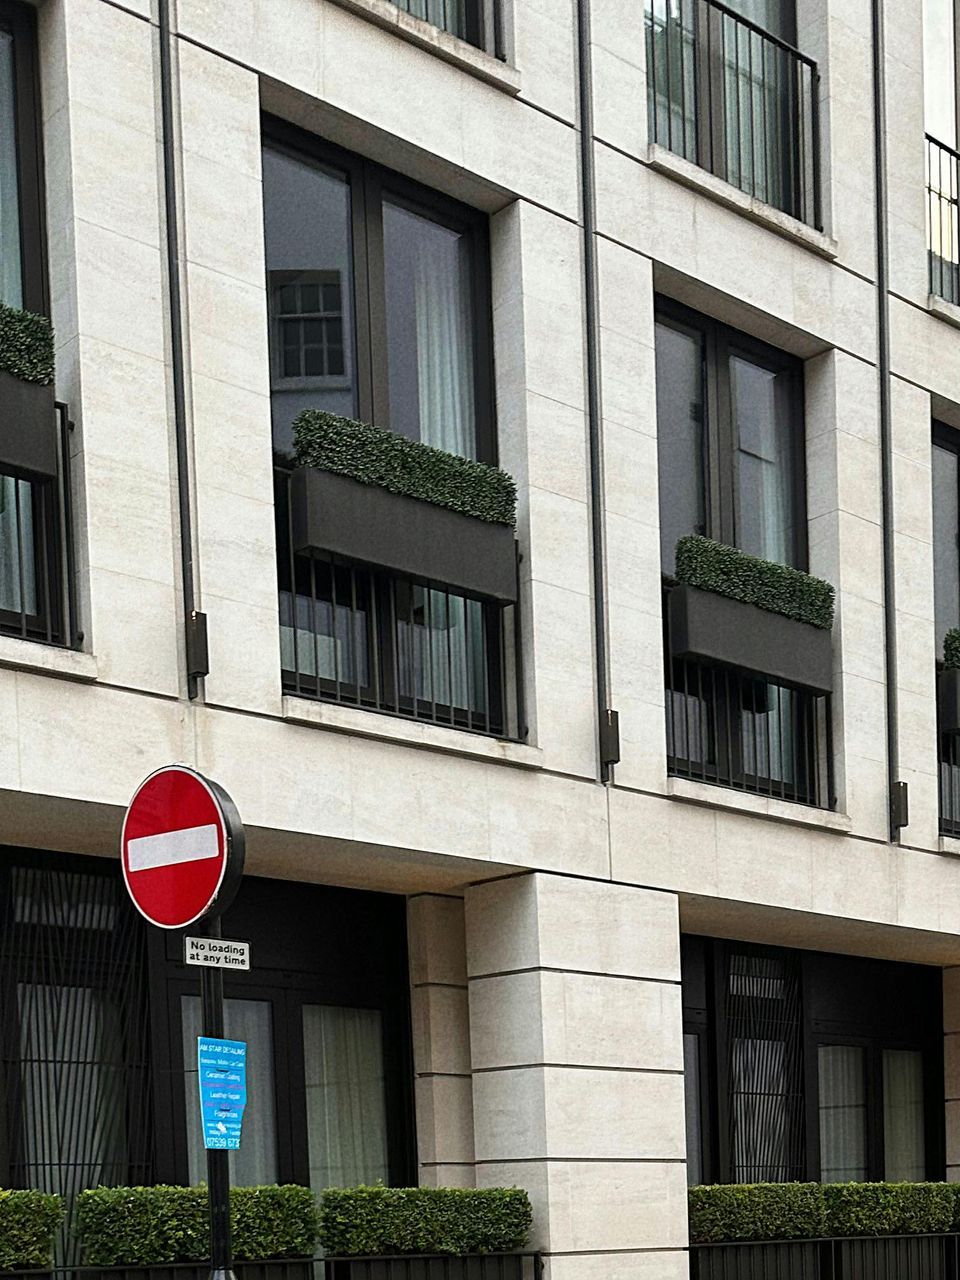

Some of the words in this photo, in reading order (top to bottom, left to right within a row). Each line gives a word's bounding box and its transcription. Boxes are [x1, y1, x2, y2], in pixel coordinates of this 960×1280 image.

[191, 941, 205, 951] No
[208, 943, 245, 956] loading
[189, 952, 201, 961] at
[203, 954, 221, 964] any
[224, 955, 246, 966] time
